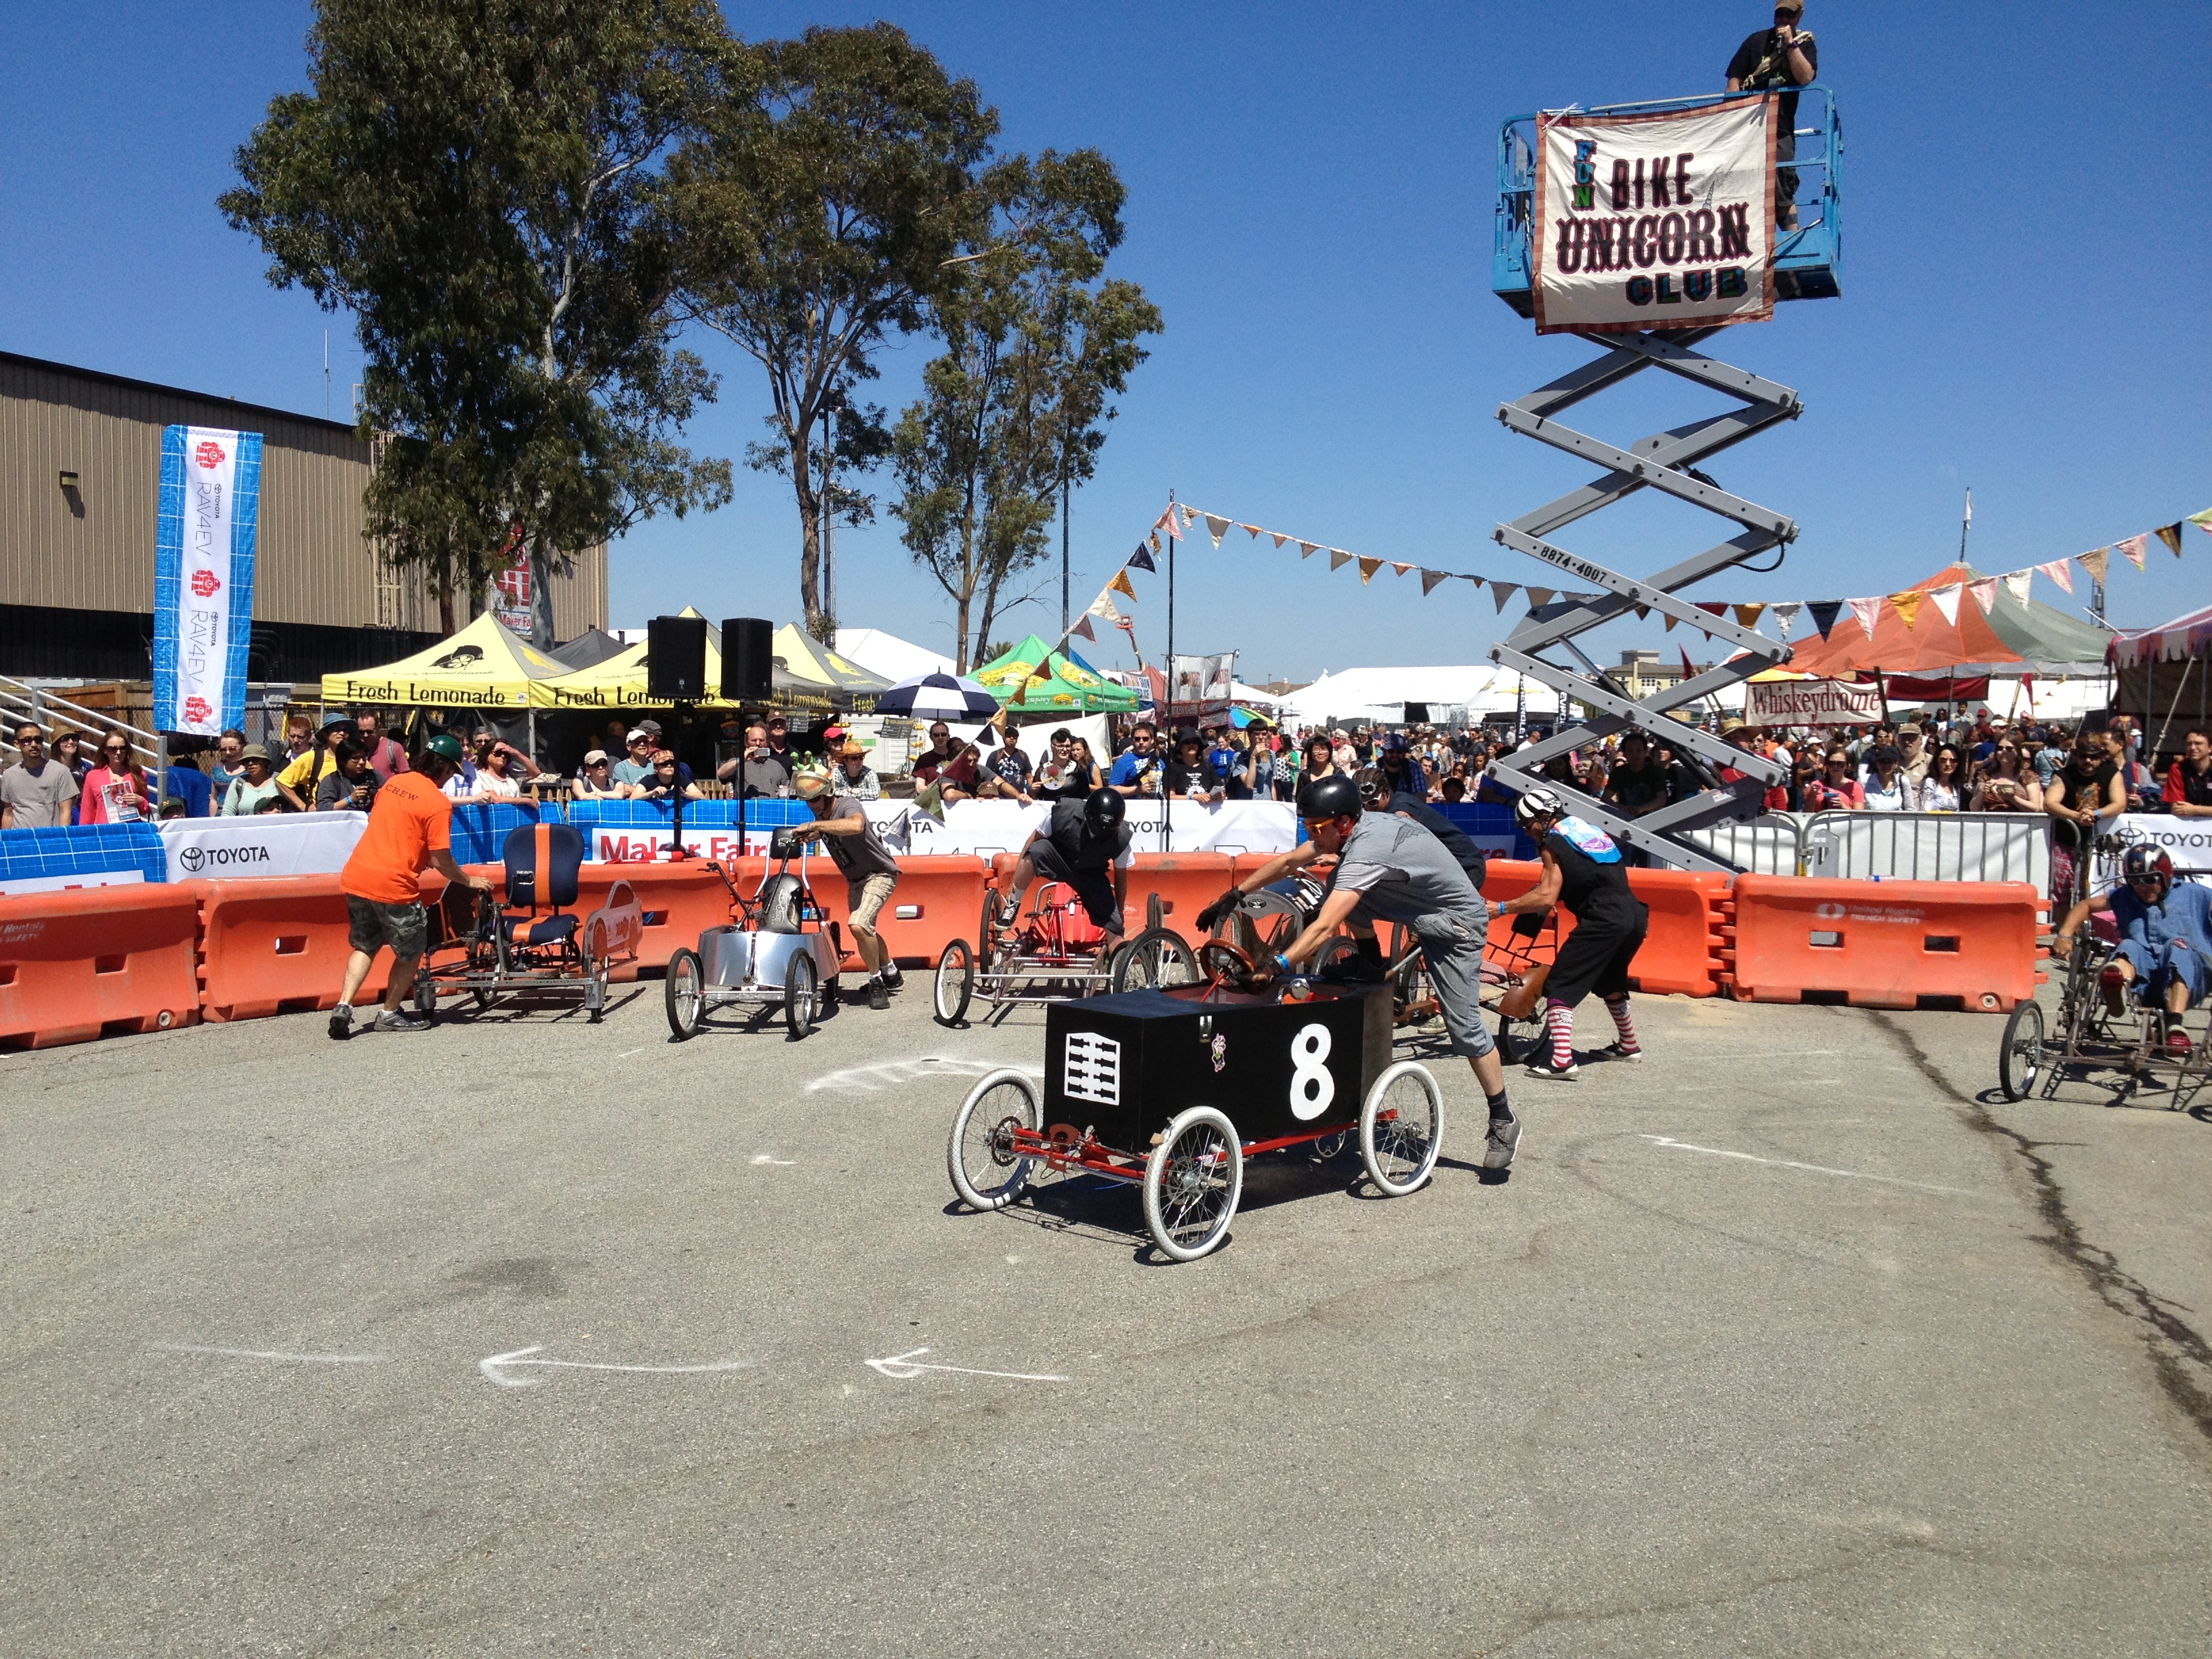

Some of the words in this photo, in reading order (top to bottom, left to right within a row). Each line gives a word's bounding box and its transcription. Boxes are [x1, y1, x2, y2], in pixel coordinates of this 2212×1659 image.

[1572, 139, 1597, 211] FUN
[1610, 152, 1694, 211] BIKE
[1555, 201, 1753, 274] UNICORN
[1625, 265, 1748, 306] CLUB
[1540, 546, 1572, 568] 8874
[1576, 563, 1607, 583] 4007
[499, 615, 521, 626] Maker
[346, 680, 398, 701] Fresh
[410, 683, 506, 705] Lemonade
[553, 687, 605, 705] Fresh
[617, 686, 715, 705] Leme
[788, 689, 833, 708] Lemonade
[853, 693, 876, 712] Fresh
[1752, 684, 1881, 721] Whiskeydrome
[385, 783, 419, 800] CREW
[870, 821, 933, 834] TOTA
[207, 846, 270, 865] TOYOTA
[600, 836, 701, 860] Makr
[1290, 1023, 1334, 1120] 8
